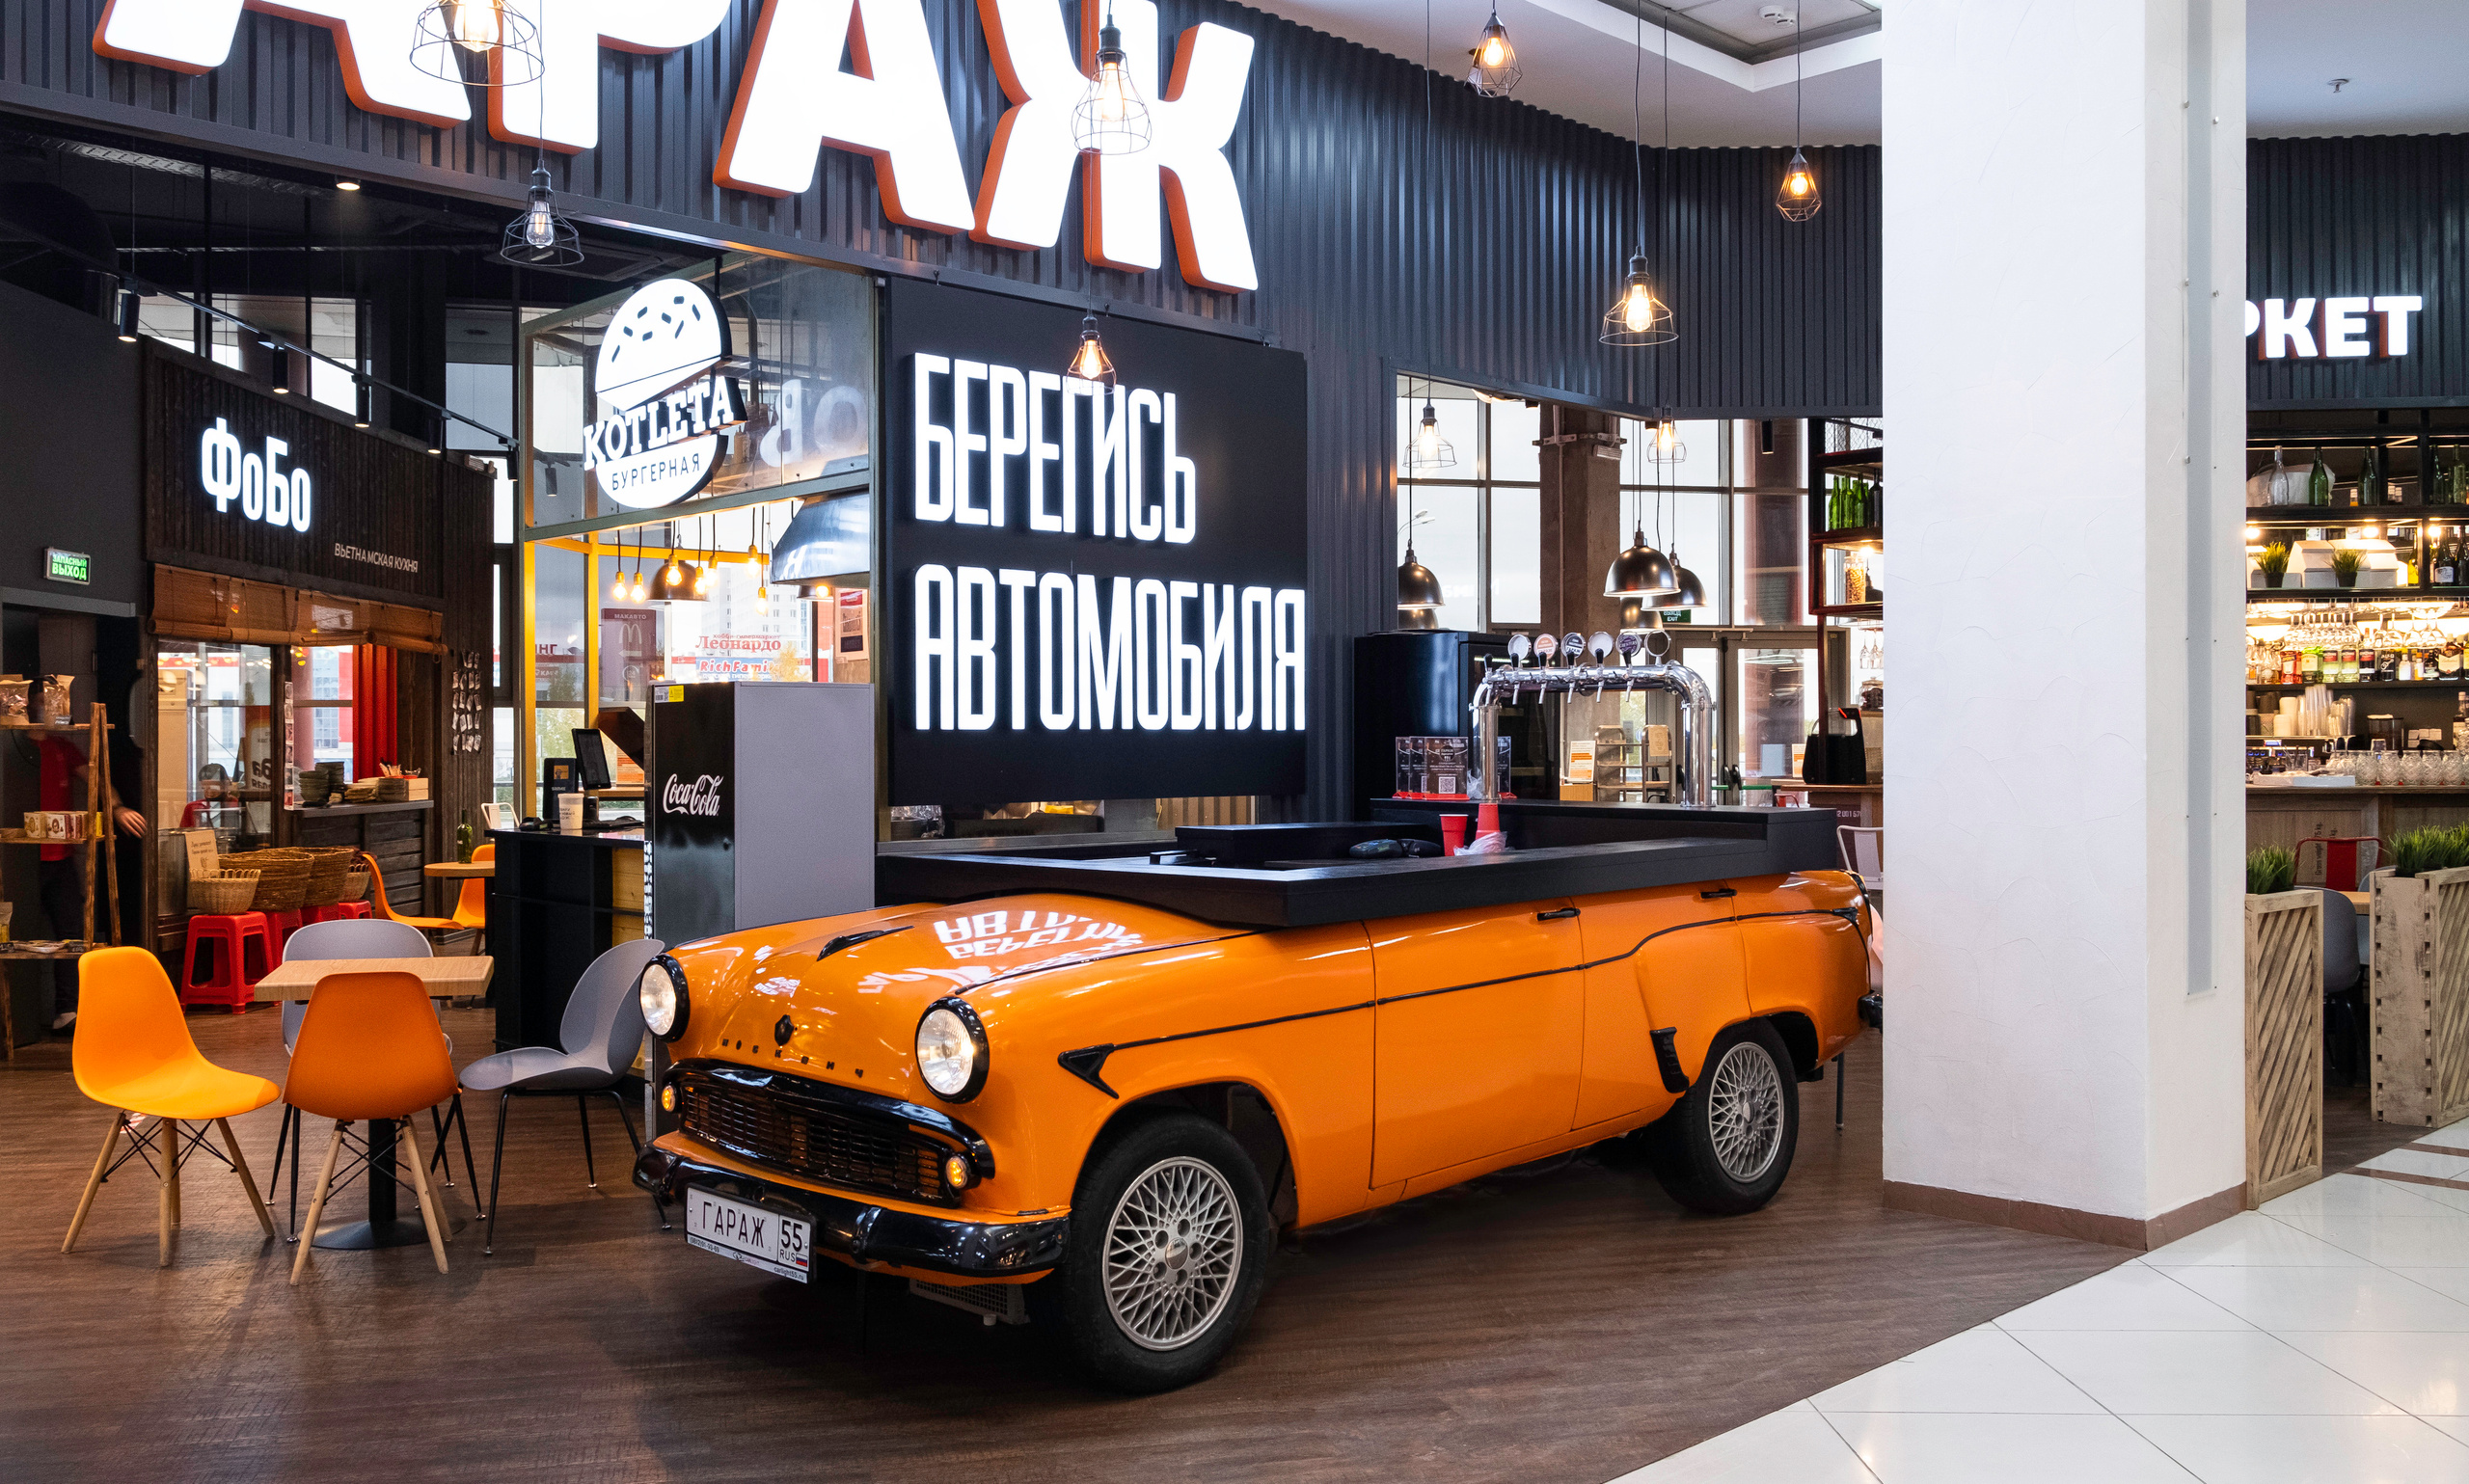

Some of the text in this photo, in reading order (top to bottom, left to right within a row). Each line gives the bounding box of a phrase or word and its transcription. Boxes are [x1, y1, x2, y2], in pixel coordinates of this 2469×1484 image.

[583, 375, 735, 472] KOTLETA
[914, 352, 1197, 544] БЕРЕГИСЬ
[611, 452, 700, 491] БУРГЕРНАЯ
[51, 562, 88, 580] ВЫХОД
[52, 553, 88, 567] ЗАПАСНЫЙ
[334, 542, 419, 574] ВЬЕТНАМСКАЯ КУХНЯ
[695, 635, 781, 653] Леонардо
[914, 563, 1306, 731] АВТОМОБИЛЯ
[663, 773, 724, 817] Coca-Cola
[702, 1201, 802, 1252] ГАРАЖ 55
[779, 1249, 796, 1263] RUS
